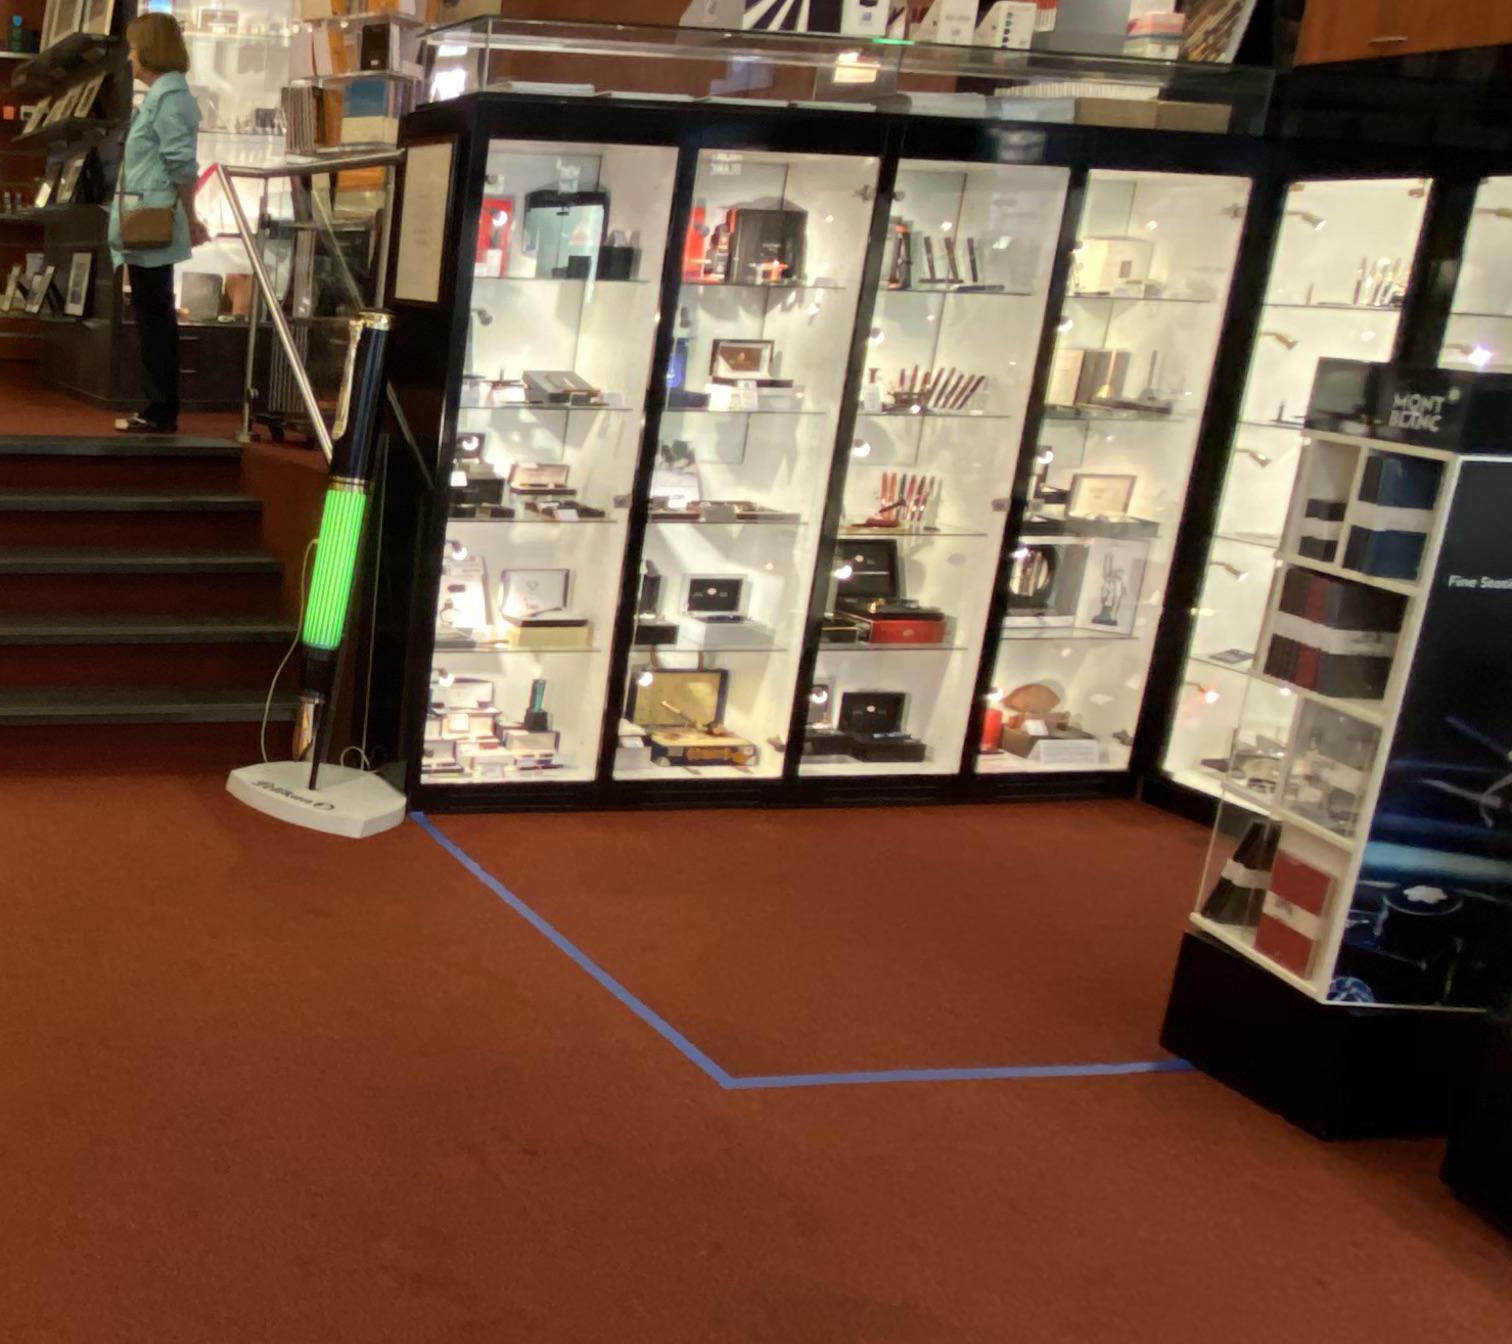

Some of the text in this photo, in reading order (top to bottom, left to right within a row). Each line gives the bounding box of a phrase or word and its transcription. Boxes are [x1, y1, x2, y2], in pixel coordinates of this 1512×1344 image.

[1391, 392, 1446, 413] MONT
[1389, 410, 1443, 432] BLANC
[1448, 574, 1477, 588] Fine
